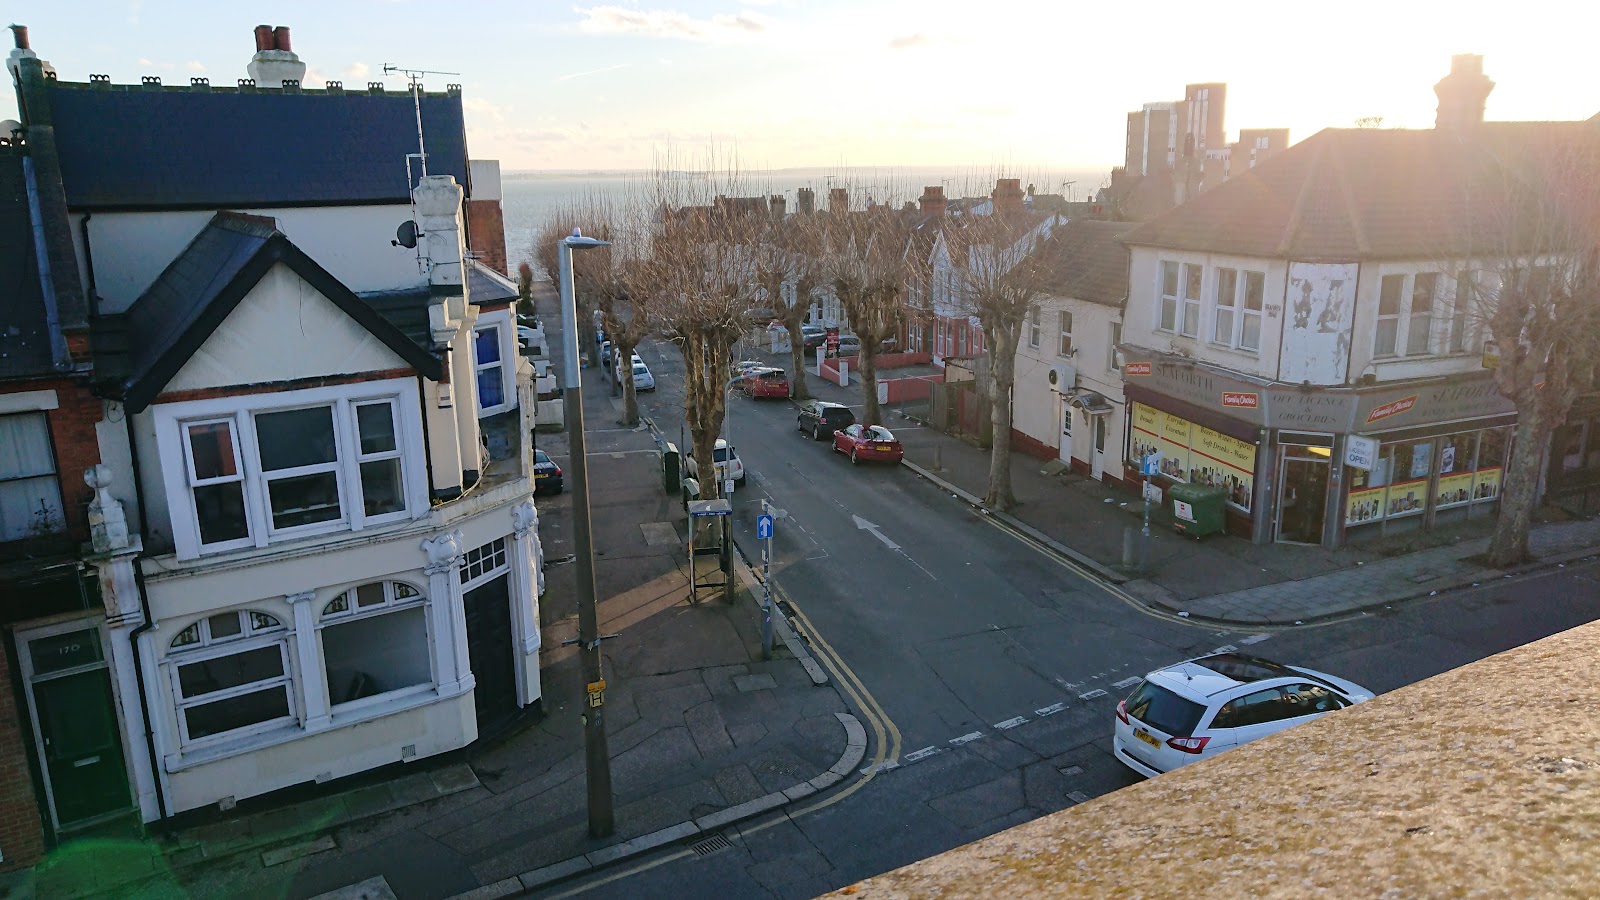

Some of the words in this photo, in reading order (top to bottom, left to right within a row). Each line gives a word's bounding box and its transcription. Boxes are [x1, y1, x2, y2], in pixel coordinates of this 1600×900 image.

[1224, 394, 1240, 406] Family
[1240, 396, 1256, 405] Choice
[1371, 405, 1393, 419] Family
[1392, 399, 1414, 413] Choice
[1202, 438, 1213, 450] Soft
[1213, 442, 1230, 454] Drinks
[1349, 453, 1371, 465] OPEN
[59, 643, 80, 655] 170
